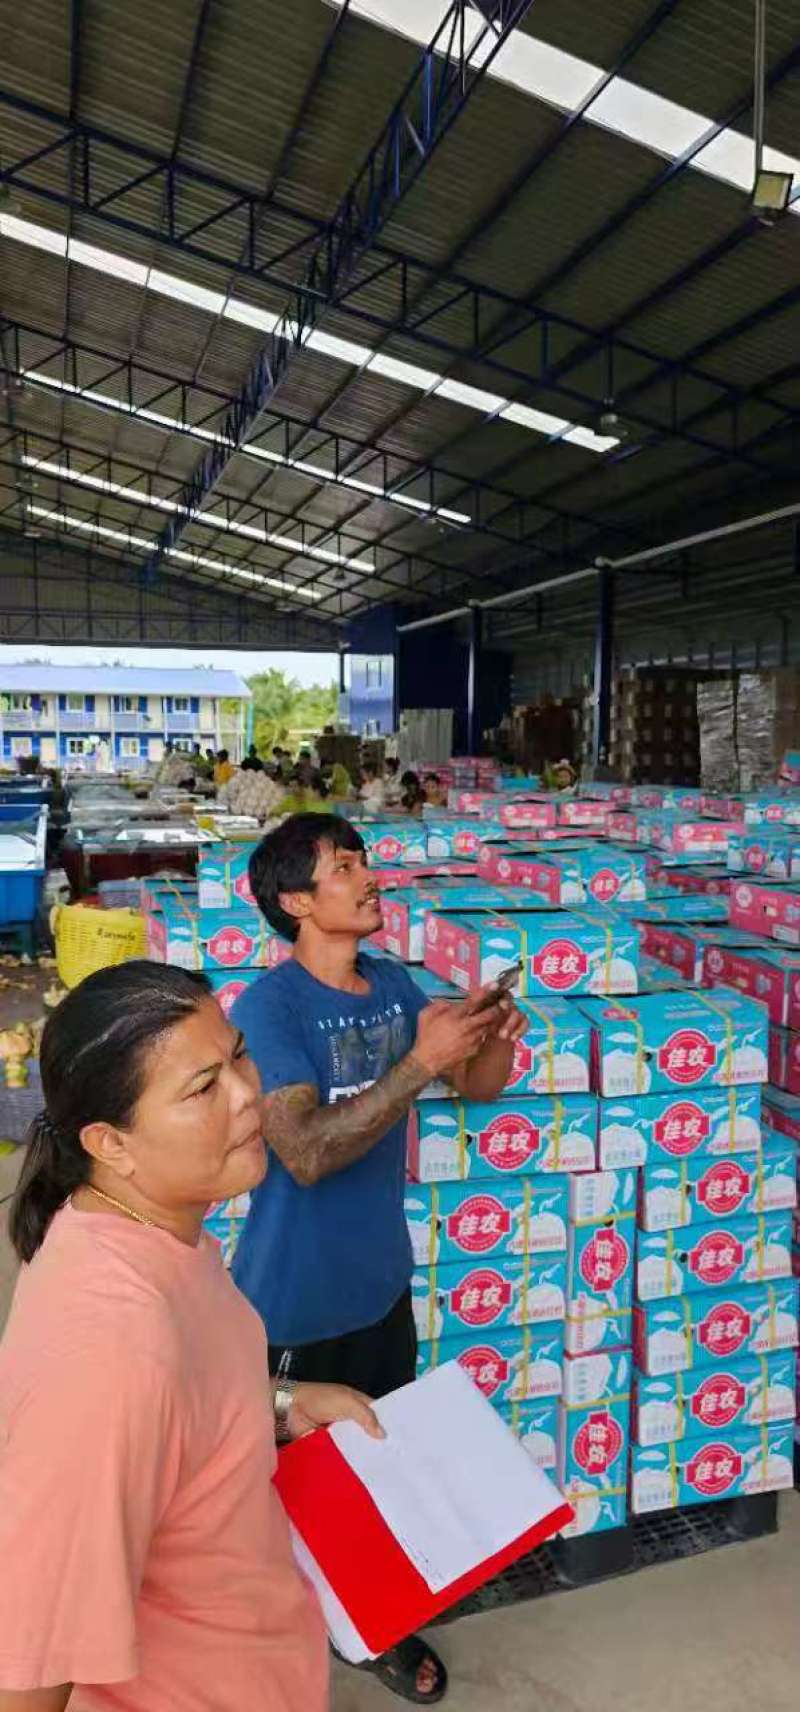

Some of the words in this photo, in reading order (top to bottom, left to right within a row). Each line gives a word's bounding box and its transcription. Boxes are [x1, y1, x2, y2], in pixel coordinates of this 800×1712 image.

[541, 955, 580, 975] 佳农
[668, 1048, 707, 1068] 佳农
[664, 1118, 703, 1140] 佳农
[489, 1132, 529, 1153] 佳农
[706, 1178, 743, 1200] 佳农
[458, 1212, 502, 1236] 佳农
[698, 1248, 736, 1270] 佳农
[459, 1286, 502, 1309] 佳农
[708, 1318, 743, 1341] 佳农
[700, 1390, 738, 1412] 佳农
[695, 1459, 733, 1481] 佳农
